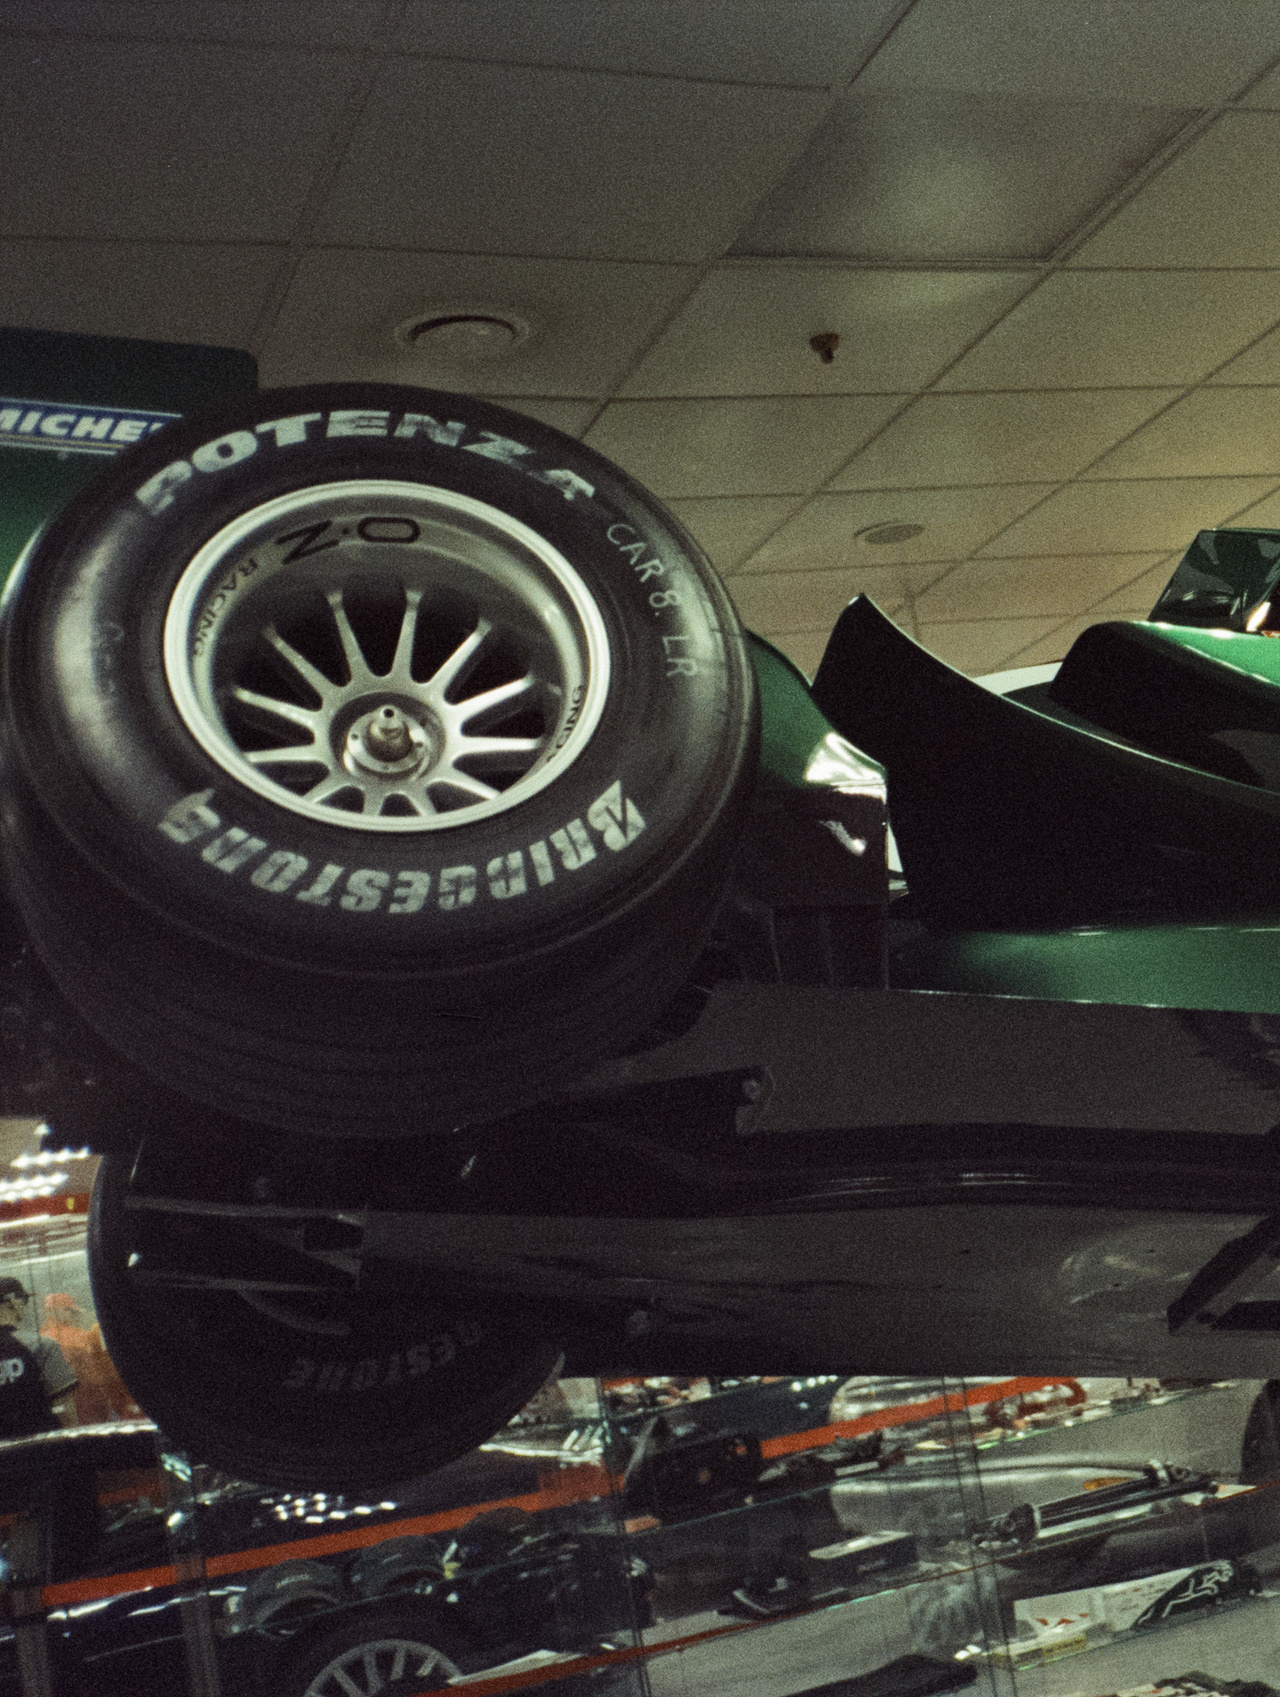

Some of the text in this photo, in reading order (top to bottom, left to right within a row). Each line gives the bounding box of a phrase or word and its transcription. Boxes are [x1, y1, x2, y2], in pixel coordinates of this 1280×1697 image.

[0, 408, 165, 442] ICHE
[135, 408, 597, 516] POTENZA
[606, 523, 665, 583] CAR
[662, 635, 700, 677] LR
[157, 780, 647, 914] BRIDGESTONE
